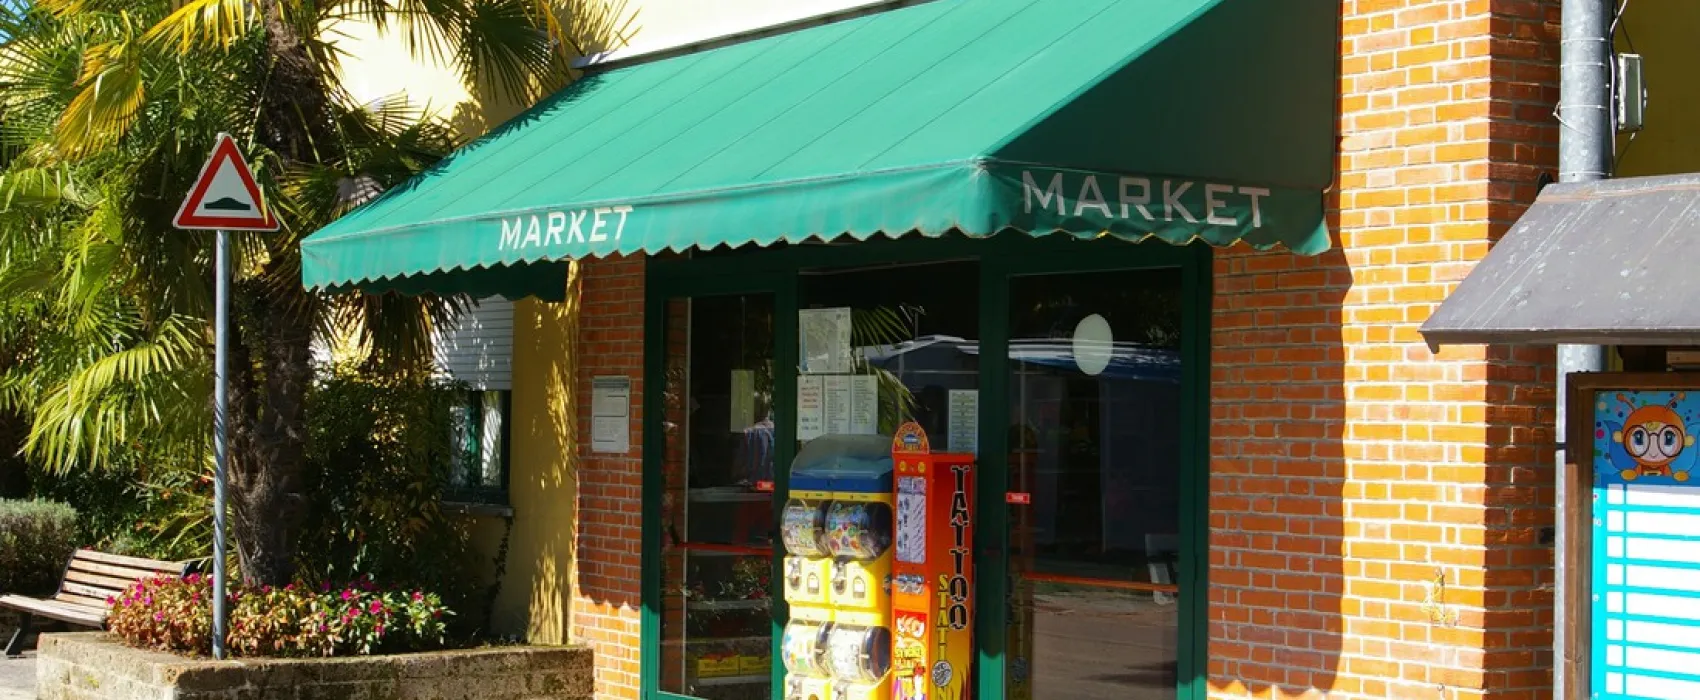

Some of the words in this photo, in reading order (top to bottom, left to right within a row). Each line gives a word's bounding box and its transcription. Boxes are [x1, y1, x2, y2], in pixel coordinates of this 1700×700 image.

[498, 205, 634, 251] MARKET
[1022, 170, 1271, 228] MARKET
[949, 465, 970, 631] TATTOO
